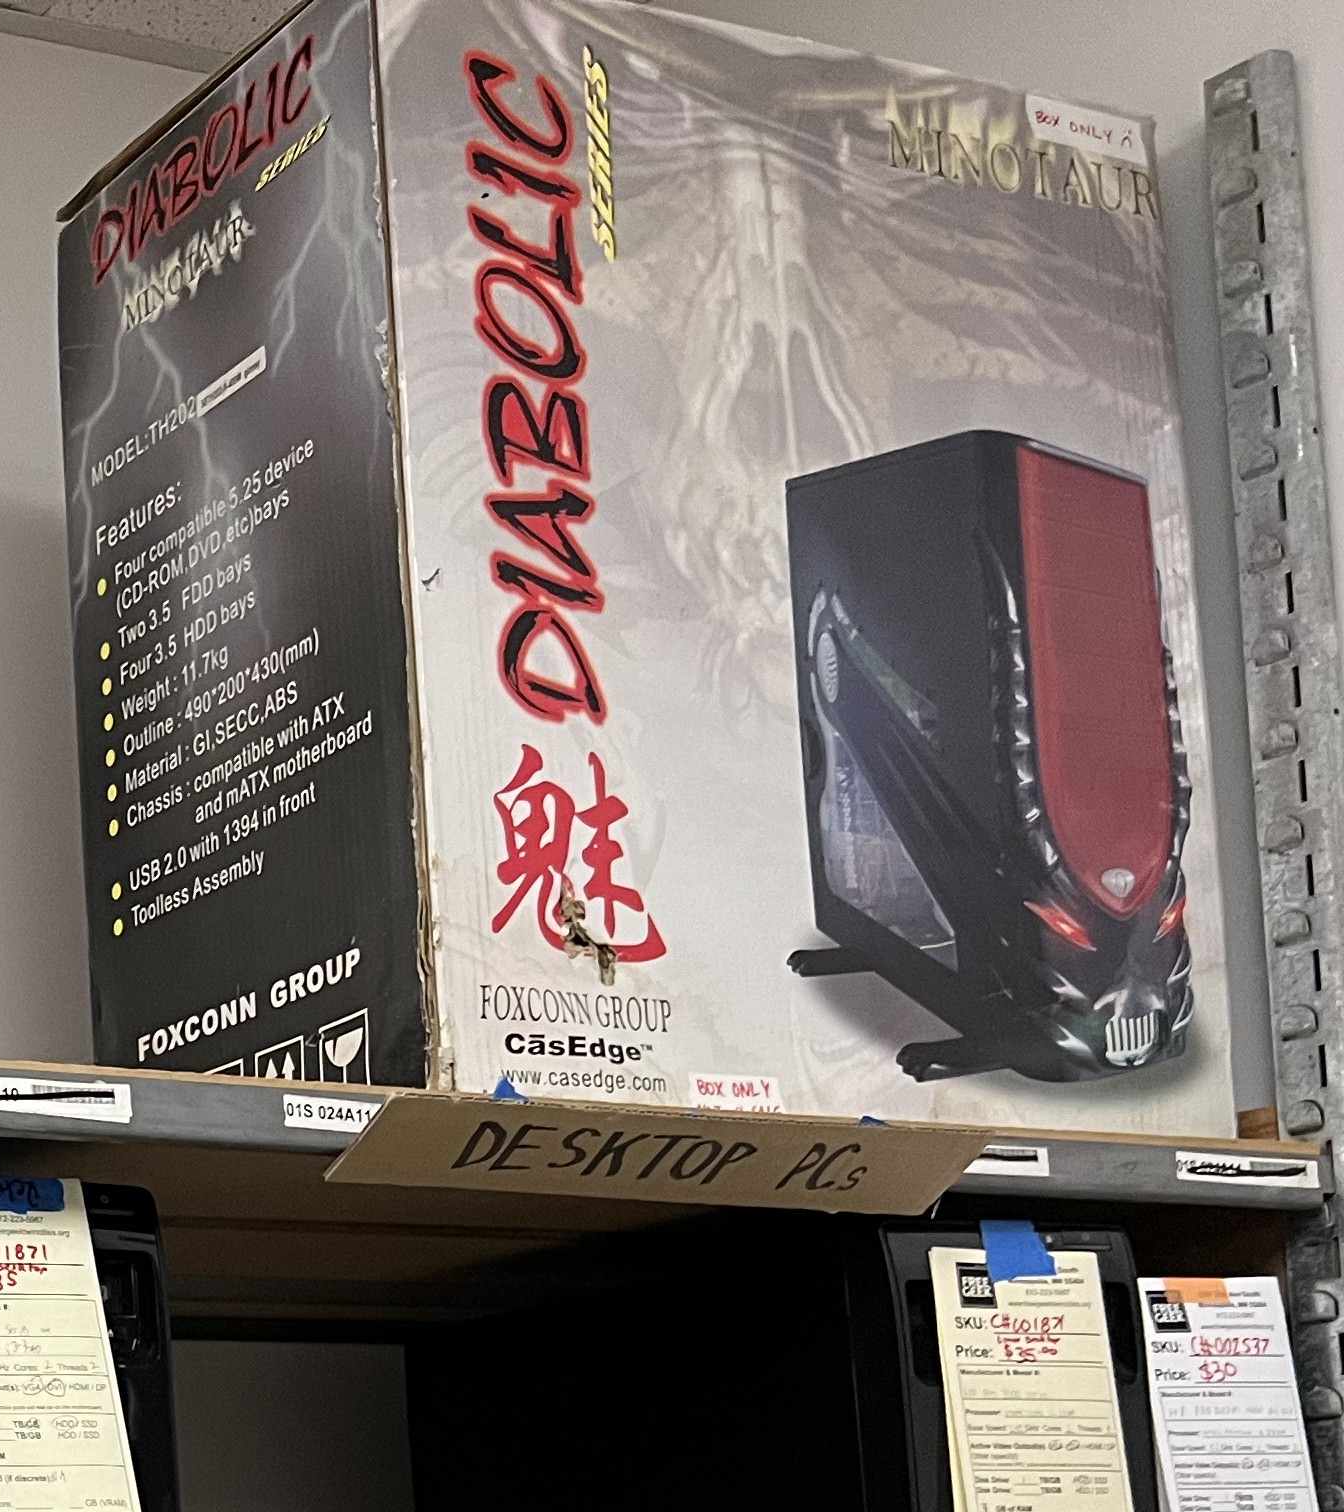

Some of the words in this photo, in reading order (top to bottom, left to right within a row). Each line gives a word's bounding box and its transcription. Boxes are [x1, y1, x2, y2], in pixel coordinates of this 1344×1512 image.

[91, 35, 313, 287] DIABOLIC
[255, 115, 331, 191] SERIES
[583, 45, 617, 263] SERIES
[1035, 110, 1059, 126] BOX
[1070, 121, 1112, 145] ONLY
[887, 119, 1158, 221] MINOTAUR
[122, 211, 249, 333] MINOTAUR
[465, 49, 608, 725] DIABOLIC
[96, 481, 181, 555] Features:
[114, 554, 146, 584] Four
[149, 500, 225, 561] compatible
[229, 473, 261, 510] 5.25
[265, 440, 314, 486] device
[117, 622, 146, 648] Two
[149, 601, 171, 629] 3.5
[181, 574, 212, 610] FDD
[217, 553, 251, 590] bays
[120, 649, 152, 685] Four
[155, 635, 177, 665] 3.5
[183, 611, 217, 647] HDD
[221, 591, 255, 626] bays
[121, 676, 171, 720] Weight
[181, 646, 228, 685] 11.7kg
[123, 716, 174, 756] Outline
[125, 745, 182, 793] Material
[127, 783, 183, 827] Chassis
[193, 737, 274, 792] compatible
[277, 716, 309, 748] with
[312, 692, 344, 731] ATX
[195, 792, 222, 824] and
[226, 766, 270, 808] mATX
[274, 711, 372, 784] motherboard
[129, 860, 161, 891] USB
[164, 846, 186, 876] 2.0
[190, 832, 219, 862] with
[223, 813, 259, 846] 1394
[262, 804, 276, 828] in
[280, 782, 316, 818] front
[489, 744, 667, 963] 魅
[131, 888, 189, 926] Toolless
[192, 851, 264, 900] Assembly
[138, 992, 256, 1062] FOXCONN
[270, 948, 360, 1008] GROUP
[480, 984, 591, 1025] FOXCONN
[596, 994, 671, 1032] GROUP
[285, 1103, 314, 1118] 01S
[501, 1069, 666, 1093] www.casedge.com
[697, 1079, 724, 1096] BOX
[732, 1080, 770, 1097] ONLY
[451, 1121, 758, 1185] DESKTOP
[775, 1143, 861, 1191] PCs
[955, 1317, 987, 1329] SKU:
[956, 1345, 994, 1358] Price:
[1155, 1369, 1190, 1381] Price:
[1198, 1360, 1237, 1382] $30
